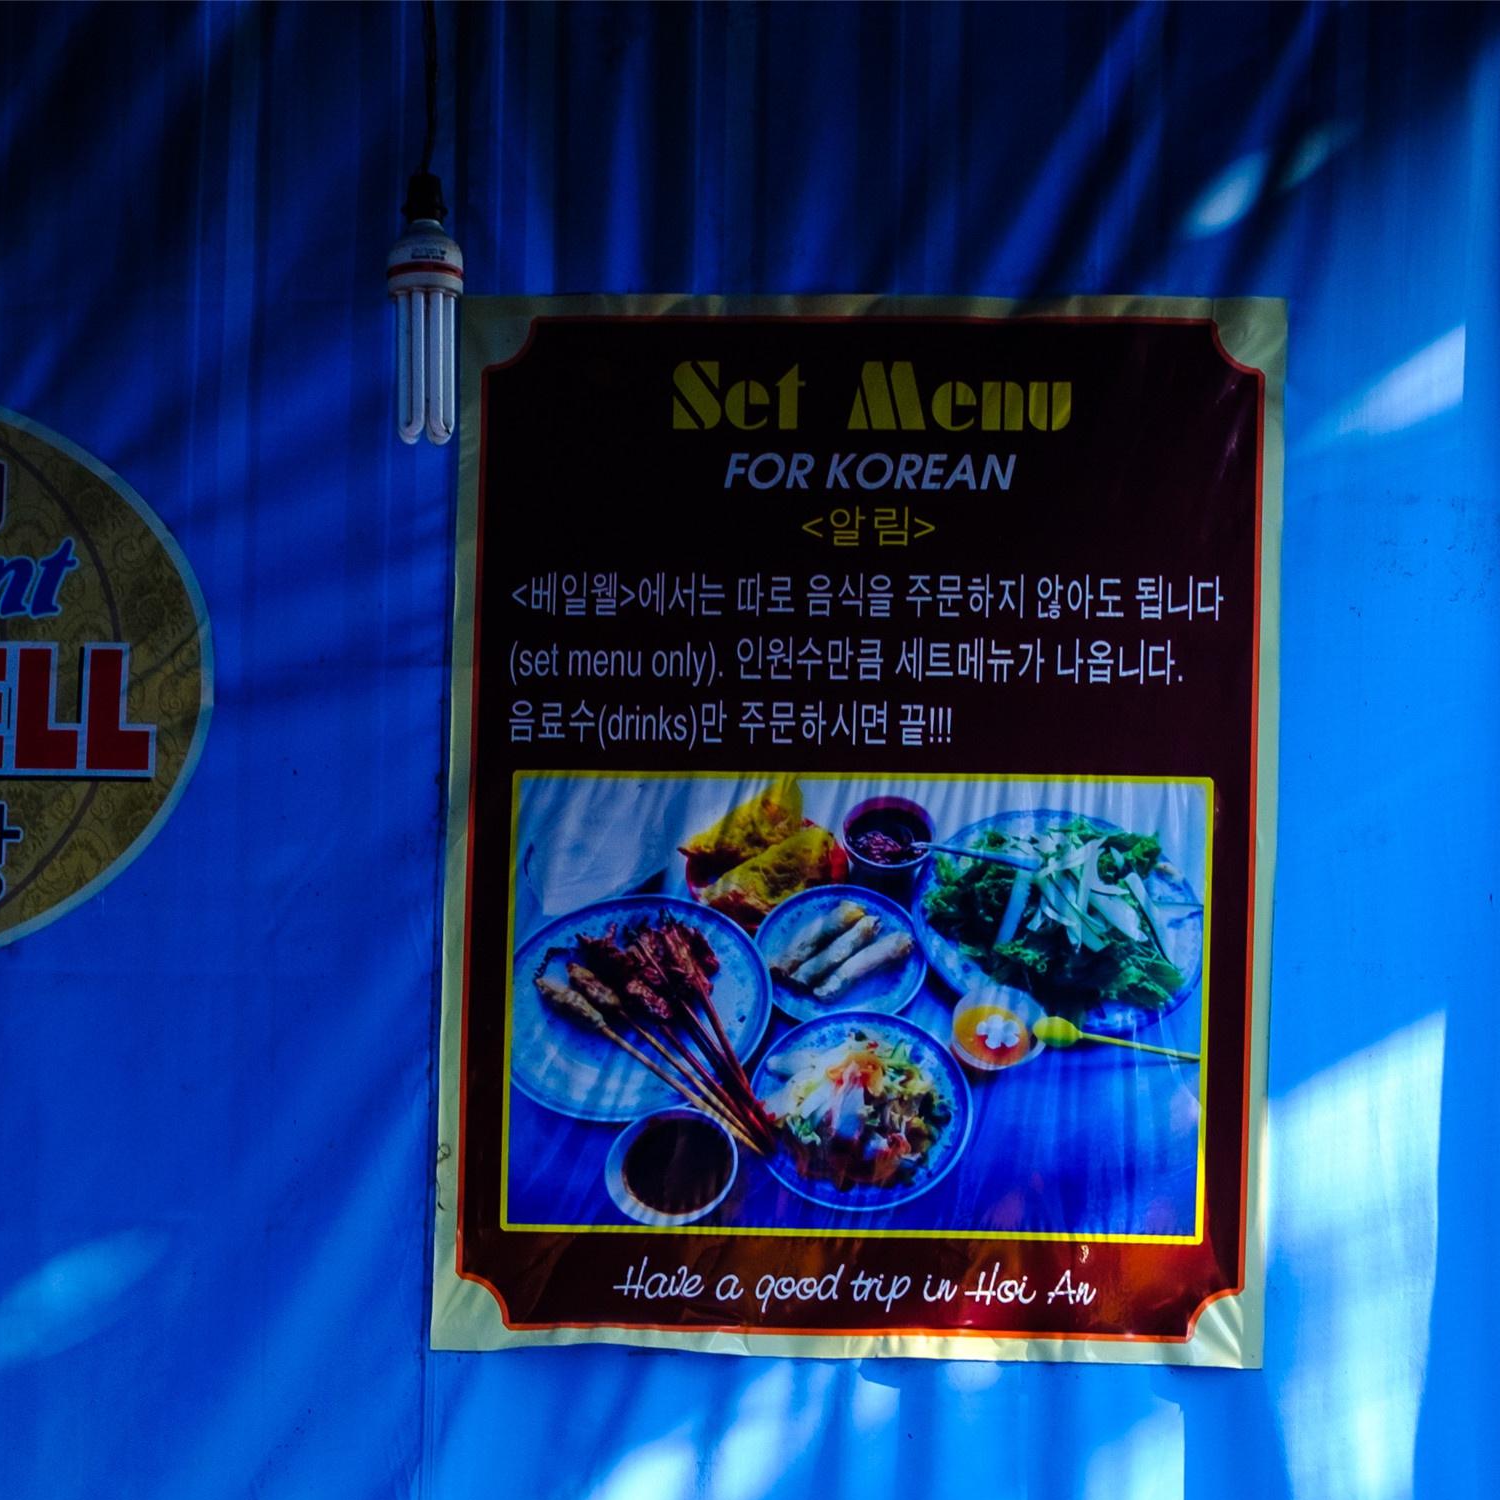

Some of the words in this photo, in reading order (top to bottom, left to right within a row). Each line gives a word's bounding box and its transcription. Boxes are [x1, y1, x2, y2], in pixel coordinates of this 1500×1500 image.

[673, 361, 806, 430] Set
[847, 361, 1072, 431] Menu
[724, 453, 815, 489] FOR
[826, 453, 1017, 490] KOREAN
[737, 572, 795, 617] 따로
[806, 573, 894, 618] 음식을
[906, 573, 1025, 619] 주문하지
[1037, 574, 1125, 620] 않아도
[1136, 575, 1224, 621] 됩니다
[510, 640, 560, 686] (set
[568, 649, 642, 678] menu
[652, 641, 724, 687] only).
[736, 637, 884, 681] 인원수만큼
[895, 637, 1045, 683] 세트메뉴가
[1056, 638, 1183, 685] 나옵니다.
[738, 699, 888, 746] 주문하시면
[899, 703, 953, 747] 끝!!!
[612, 1256, 705, 1300] Have
[715, 1273, 744, 1301] a
[755, 1263, 846, 1314] good
[850, 1270, 912, 1313] trip
[922, 1273, 959, 1303] in
[964, 1262, 1037, 1306] Hoi
[1047, 1269, 1097, 1306] An
